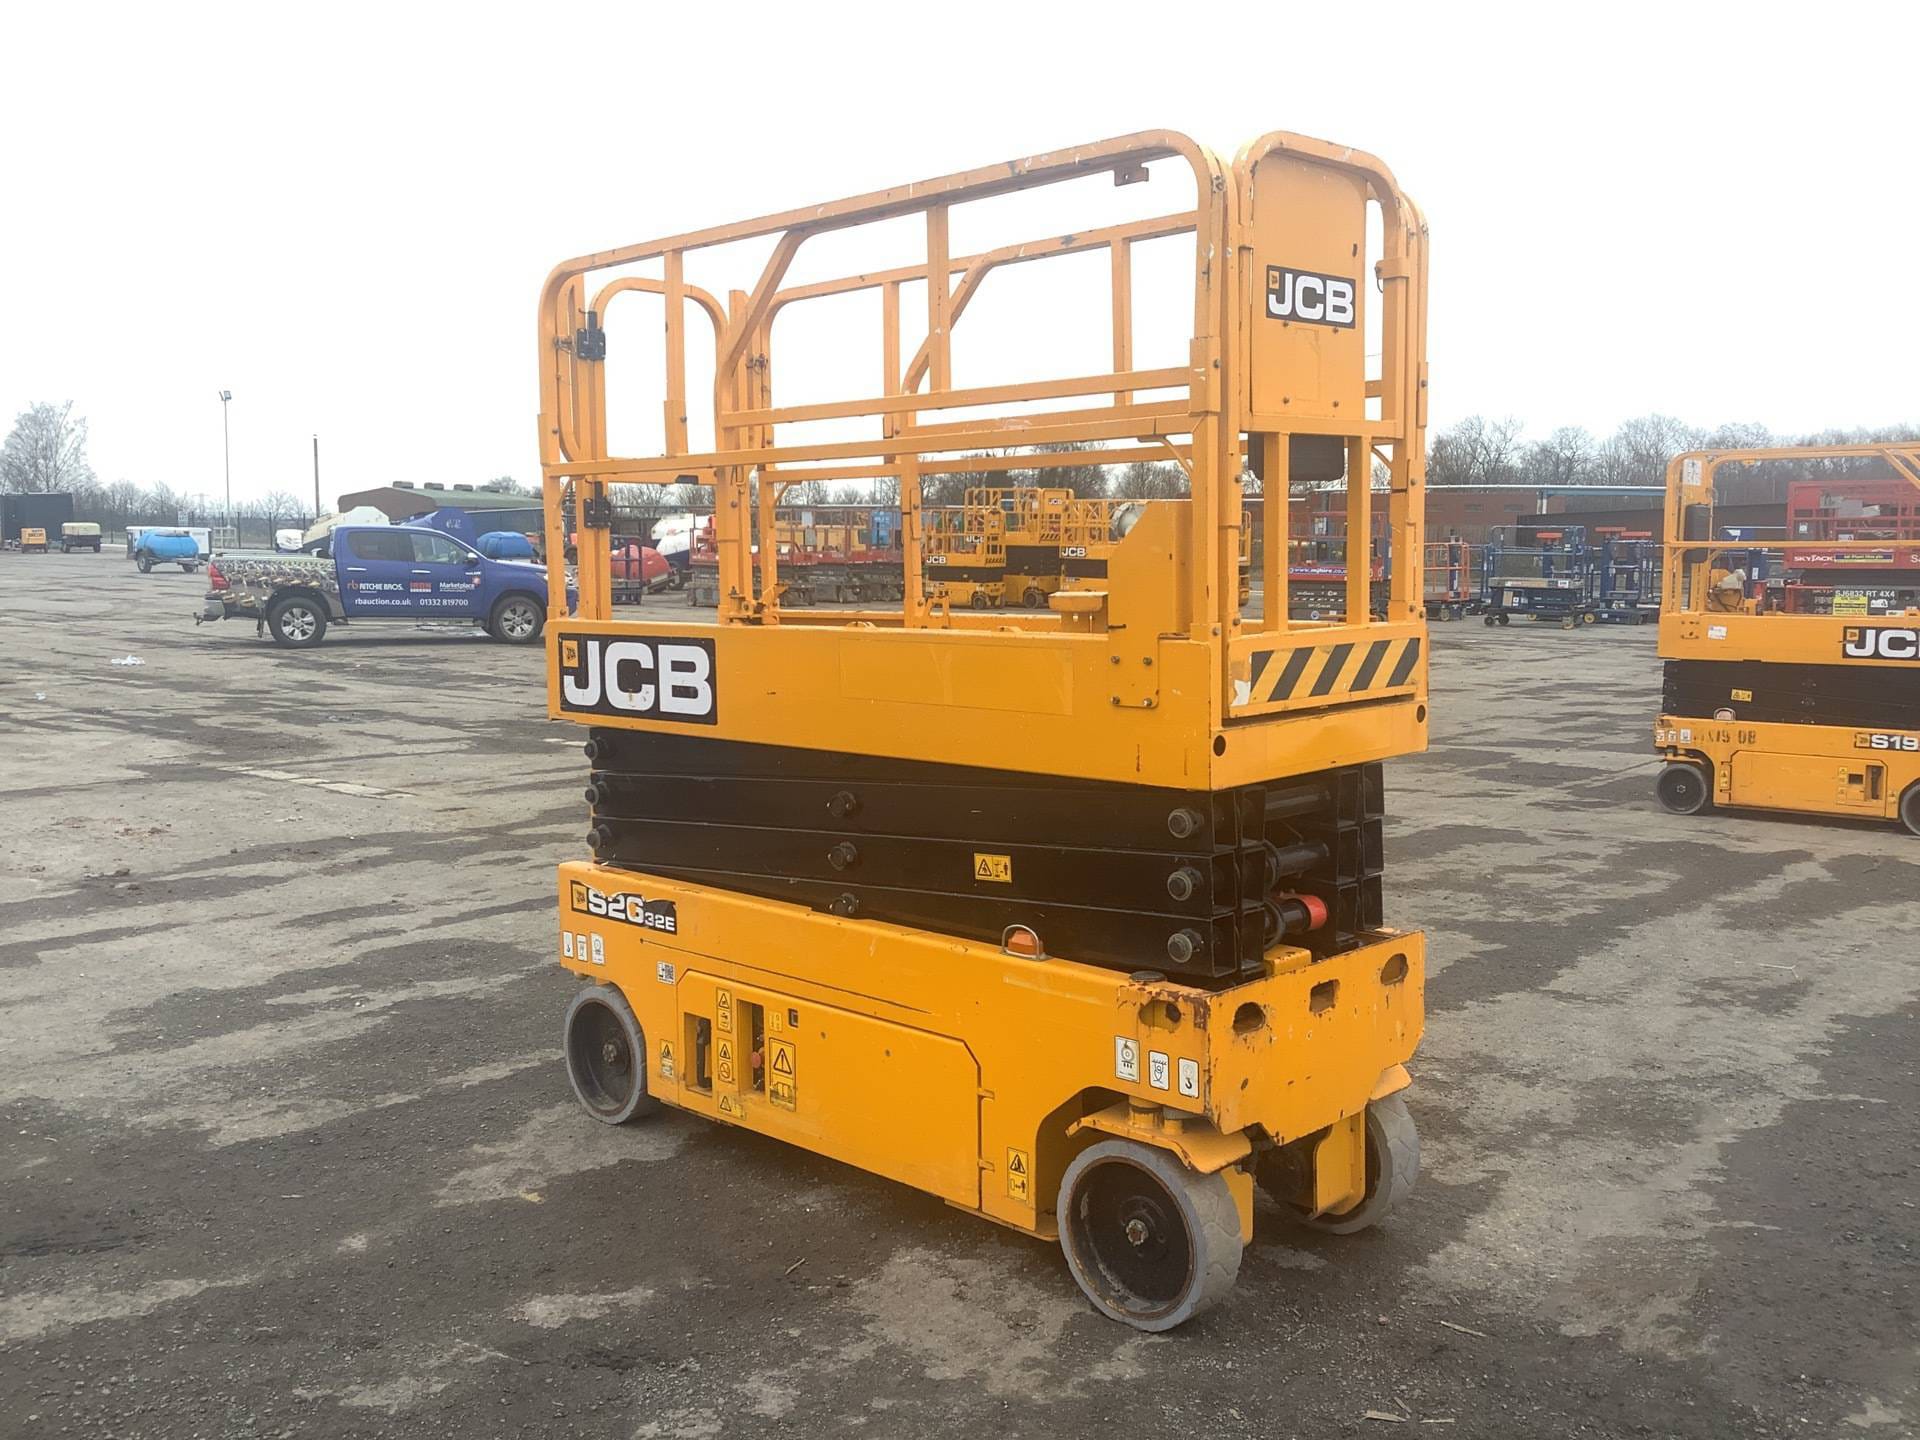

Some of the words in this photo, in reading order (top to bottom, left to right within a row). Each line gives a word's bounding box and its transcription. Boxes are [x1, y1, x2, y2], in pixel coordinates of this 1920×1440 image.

[1269, 273, 1354, 323] JCB
[926, 555, 947, 564] JCB
[1061, 547, 1086, 557] JCB
[355, 598, 411, 606] rbauction.co.uk
[1846, 629, 1920, 658] JC
[564, 641, 712, 715] JCB
[1871, 734, 1919, 750] S19
